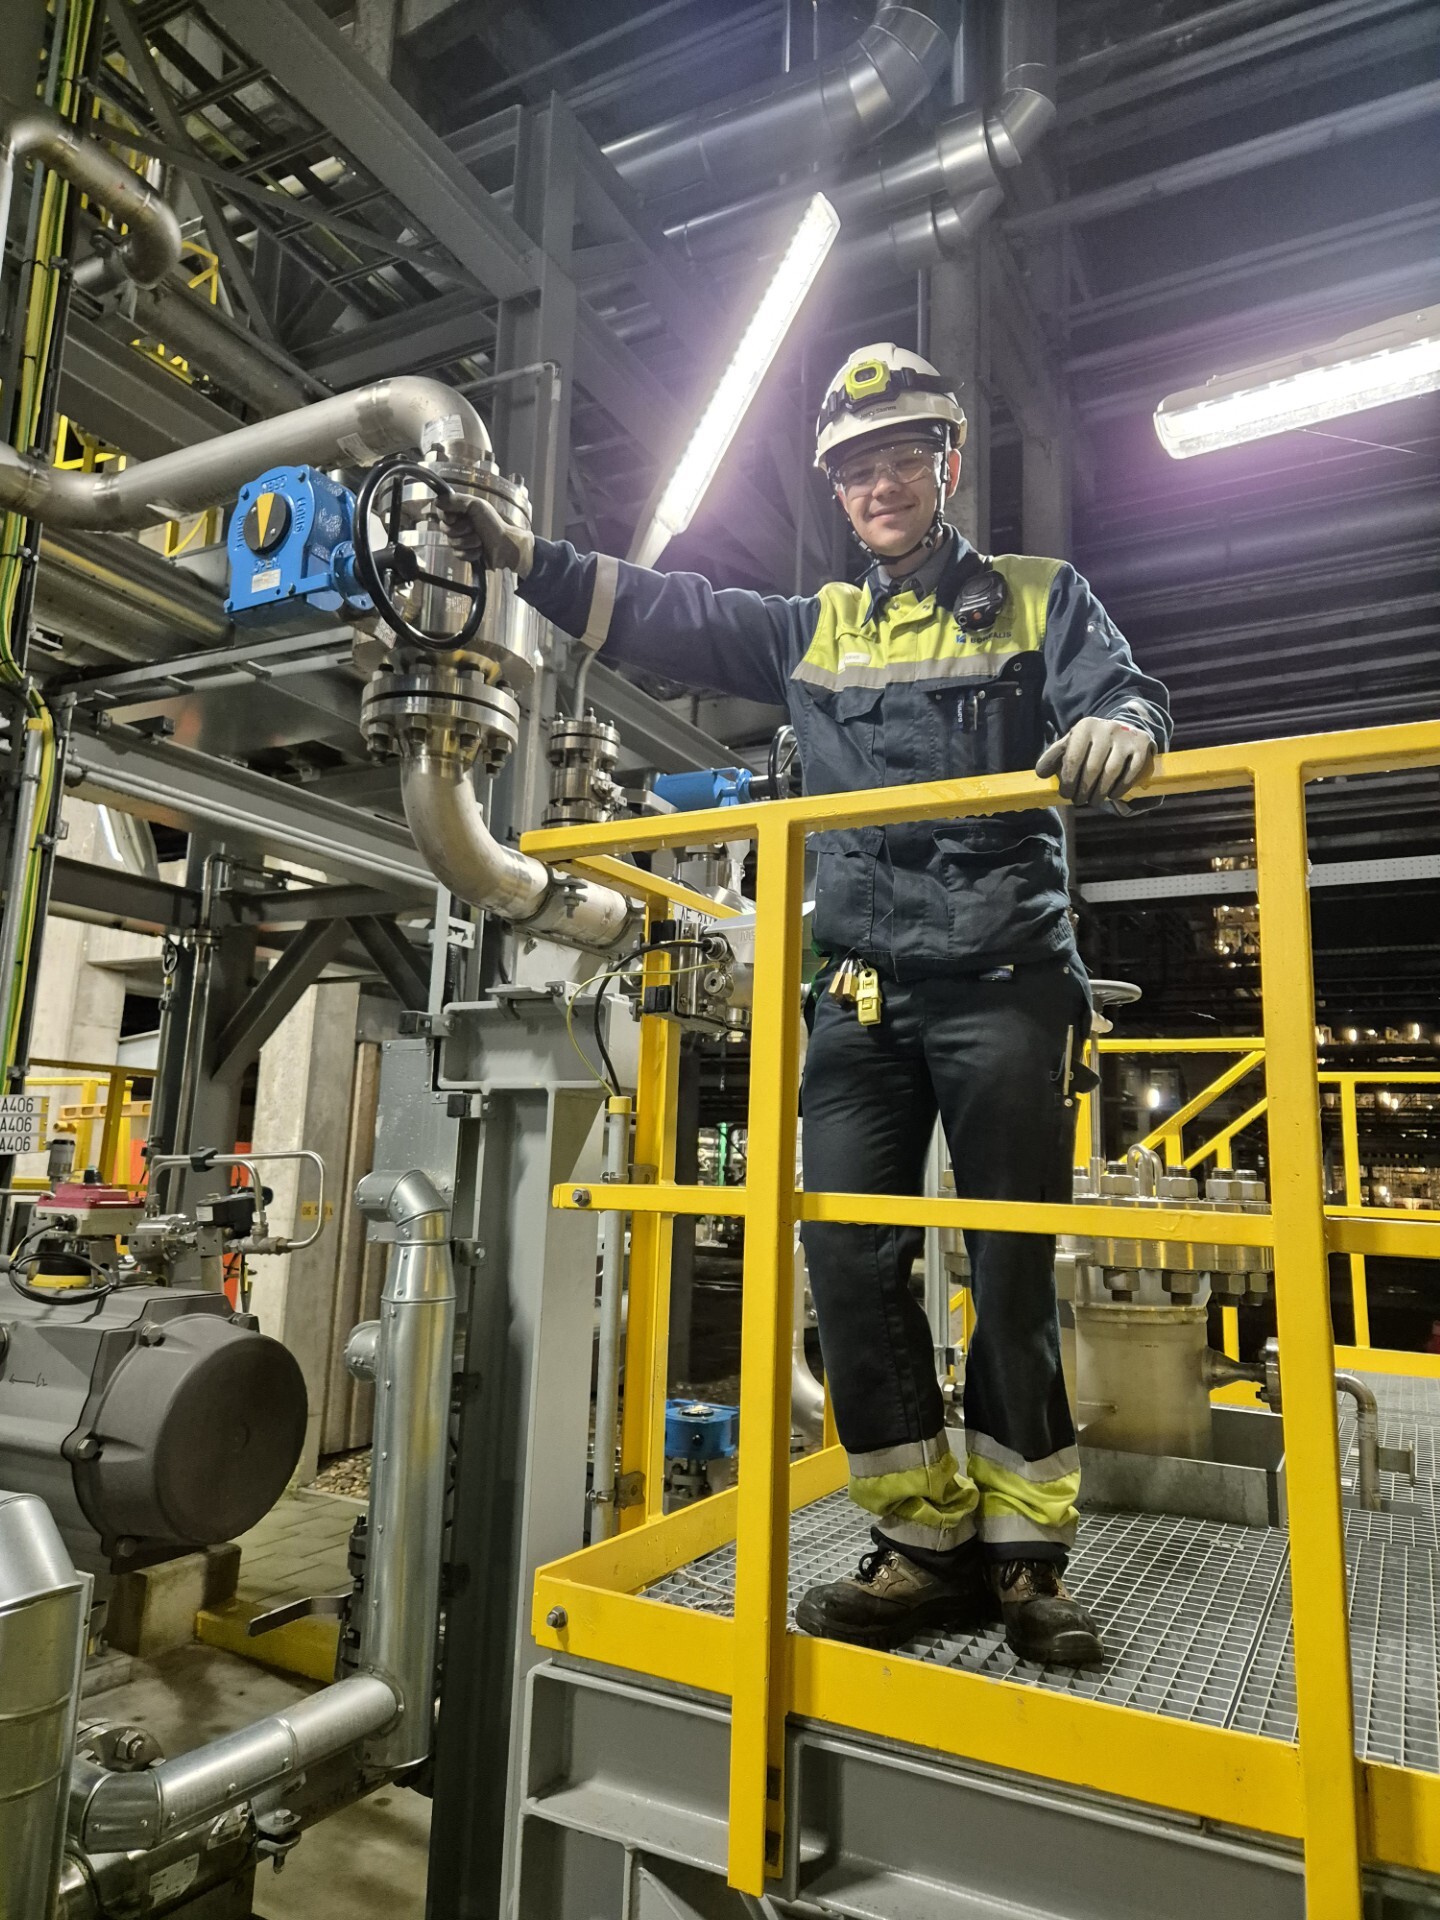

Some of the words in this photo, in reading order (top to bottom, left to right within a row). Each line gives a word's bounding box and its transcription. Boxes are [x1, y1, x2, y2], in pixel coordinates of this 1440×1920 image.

[1, 1097, 34, 1113] A406
[0, 1116, 33, 1133] A406
[0, 1136, 31, 1152] A406
